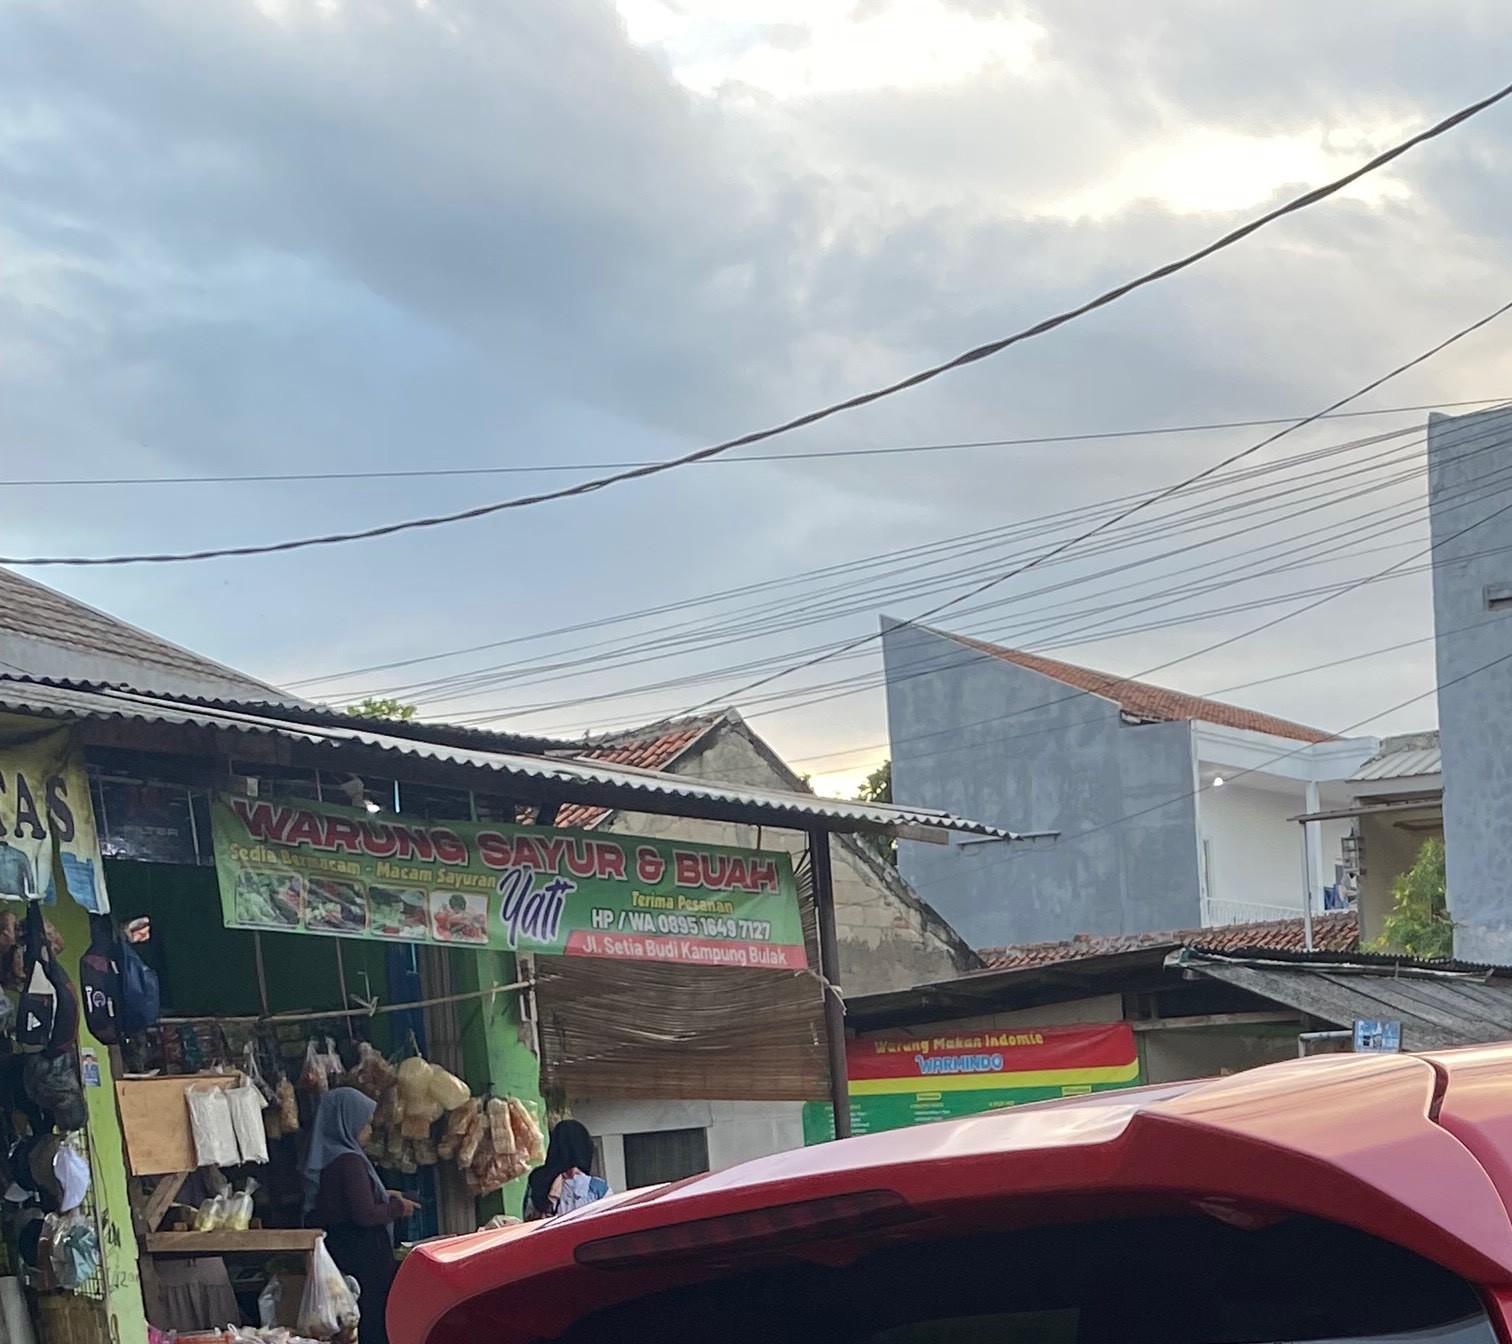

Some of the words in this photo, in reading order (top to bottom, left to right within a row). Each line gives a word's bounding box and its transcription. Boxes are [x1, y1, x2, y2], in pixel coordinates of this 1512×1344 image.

[0, 770, 75, 842] AS
[229, 799, 469, 867] WARUNG
[475, 831, 629, 880] SAYUR
[635, 845, 665, 884] &
[673, 849, 781, 895] BUAH
[229, 843, 279, 865] Sedia
[281, 849, 361, 876] Bermacam
[376, 861, 433, 883] Macam
[437, 868, 497, 890] Sayuran
[498, 867, 577, 949] Yati
[631, 890, 675, 910] Terima
[677, 895, 735, 914] Pesanan
[592, 909, 614, 928] HP
[617, 911, 626, 930] /
[629, 913, 657, 933] WA
[658, 915, 699, 935] 0895
[700, 917, 738, 938] 1649
[740, 919, 772, 941] 7127
[582, 935, 601, 954] Jl.
[603, 938, 645, 957] Setia
[646, 940, 679, 959] Budi
[682, 942, 747, 967] Kampung
[749, 947, 788, 966] Bulak
[875, 1040, 930, 1055] Warung
[933, 1036, 982, 1051] Makan
[985, 1031, 1044, 1047] Indomie
[914, 1054, 1004, 1075] WARMINDO
